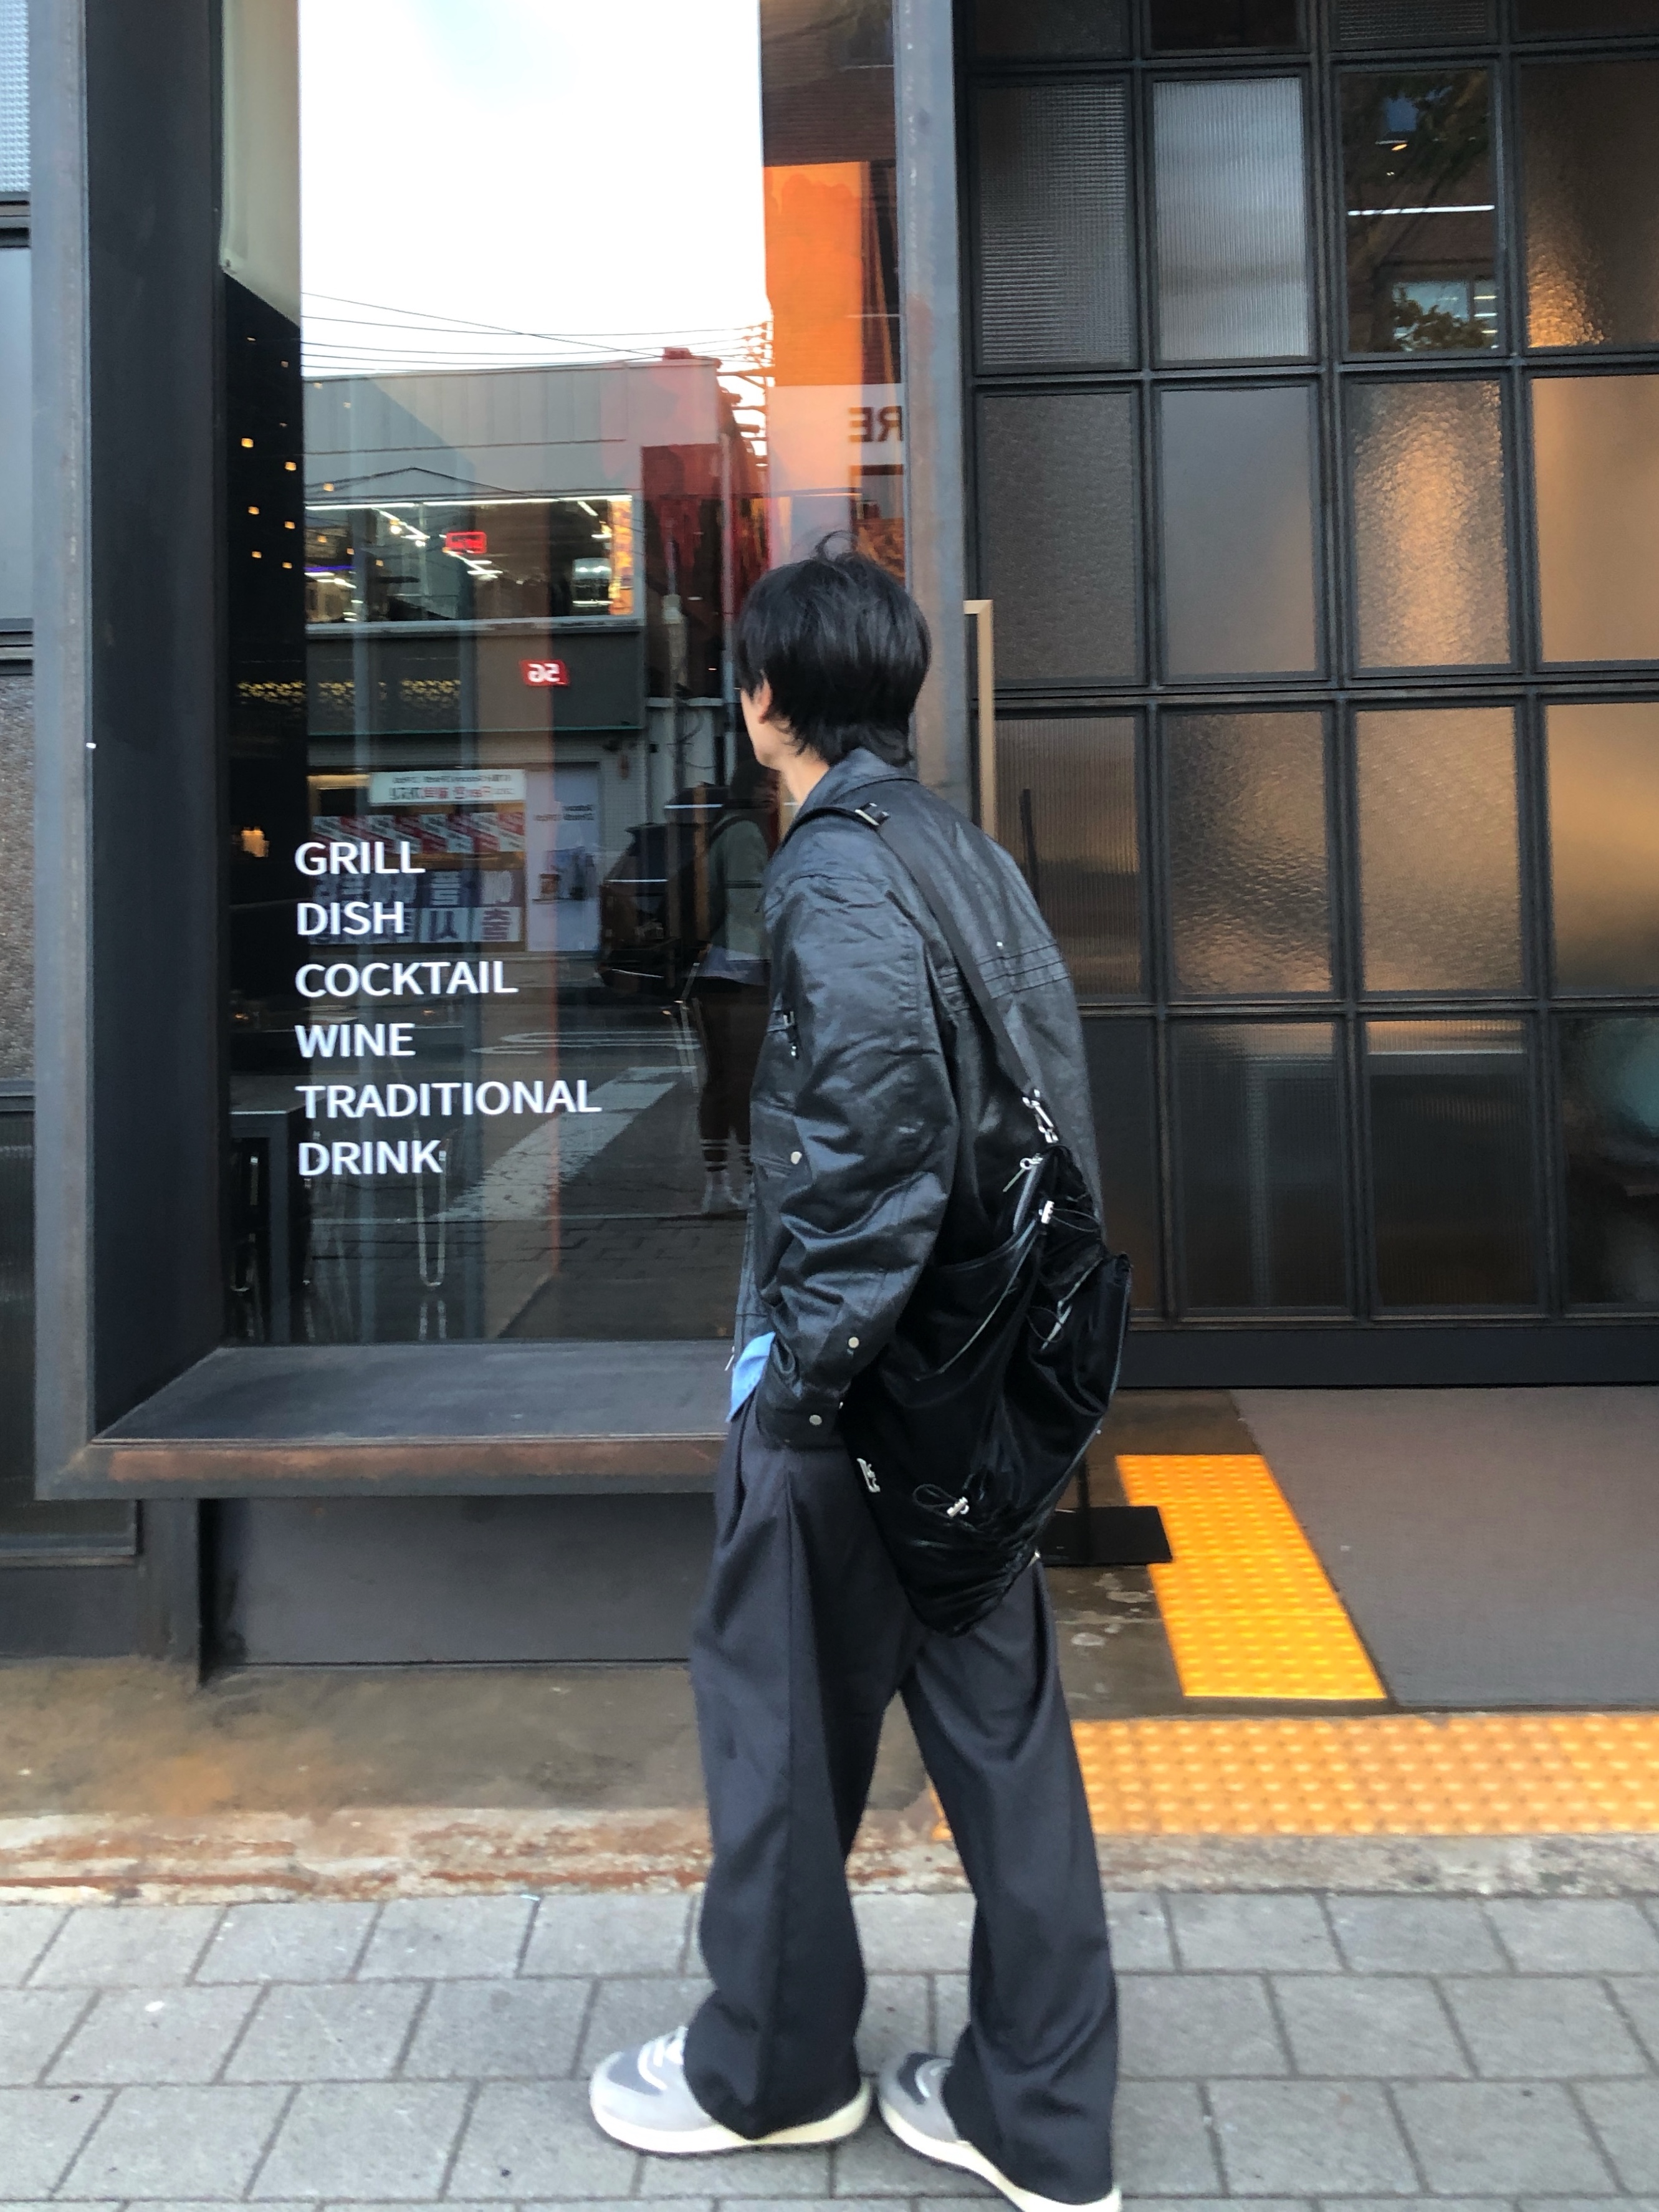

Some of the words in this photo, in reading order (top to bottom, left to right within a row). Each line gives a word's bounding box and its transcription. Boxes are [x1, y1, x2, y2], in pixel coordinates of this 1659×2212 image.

[295, 840, 426, 876] GRILL
[297, 901, 405, 936] DISH
[295, 960, 519, 998] COCKTAIL
[294, 1022, 416, 1058] WINE
[295, 1079, 603, 1119] TRADITIONAL
[298, 1139, 444, 1176] DRINK
